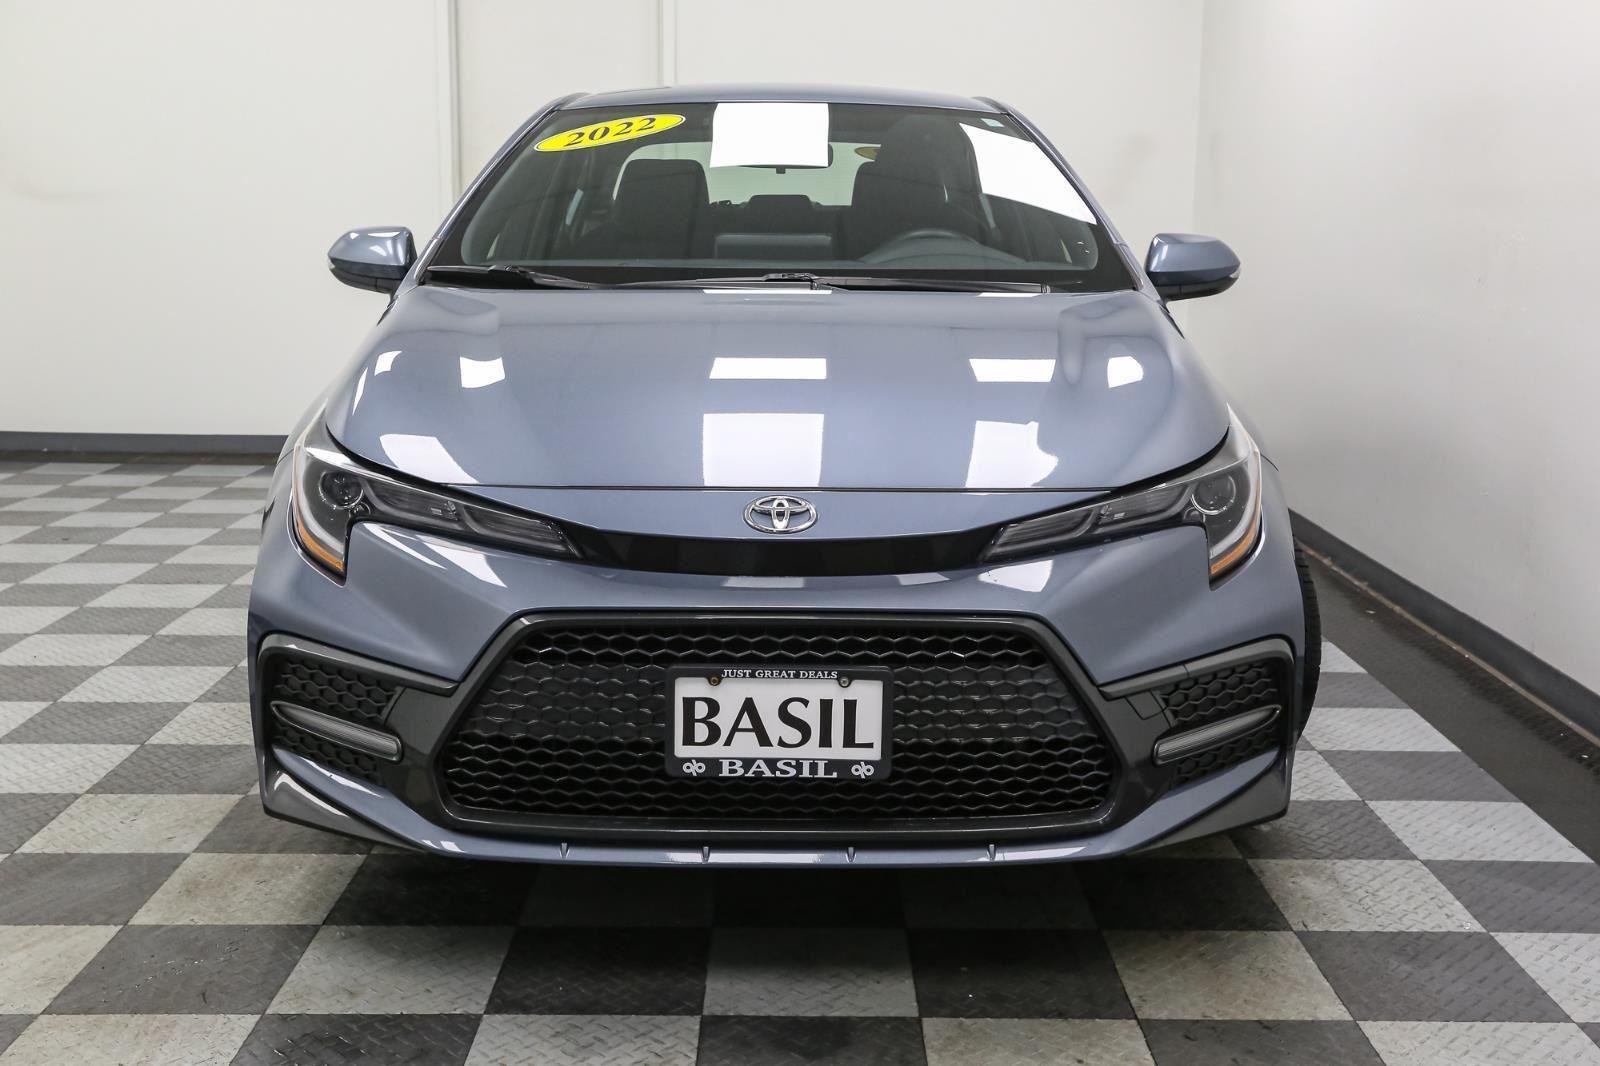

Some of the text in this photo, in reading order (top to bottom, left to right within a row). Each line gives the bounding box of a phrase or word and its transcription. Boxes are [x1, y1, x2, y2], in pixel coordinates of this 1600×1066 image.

[563, 117, 656, 147] 2022
[721, 669, 838, 679] JUST GREAT DEALS
[682, 696, 874, 748] BASIL
[718, 759, 838, 778] BASIL
